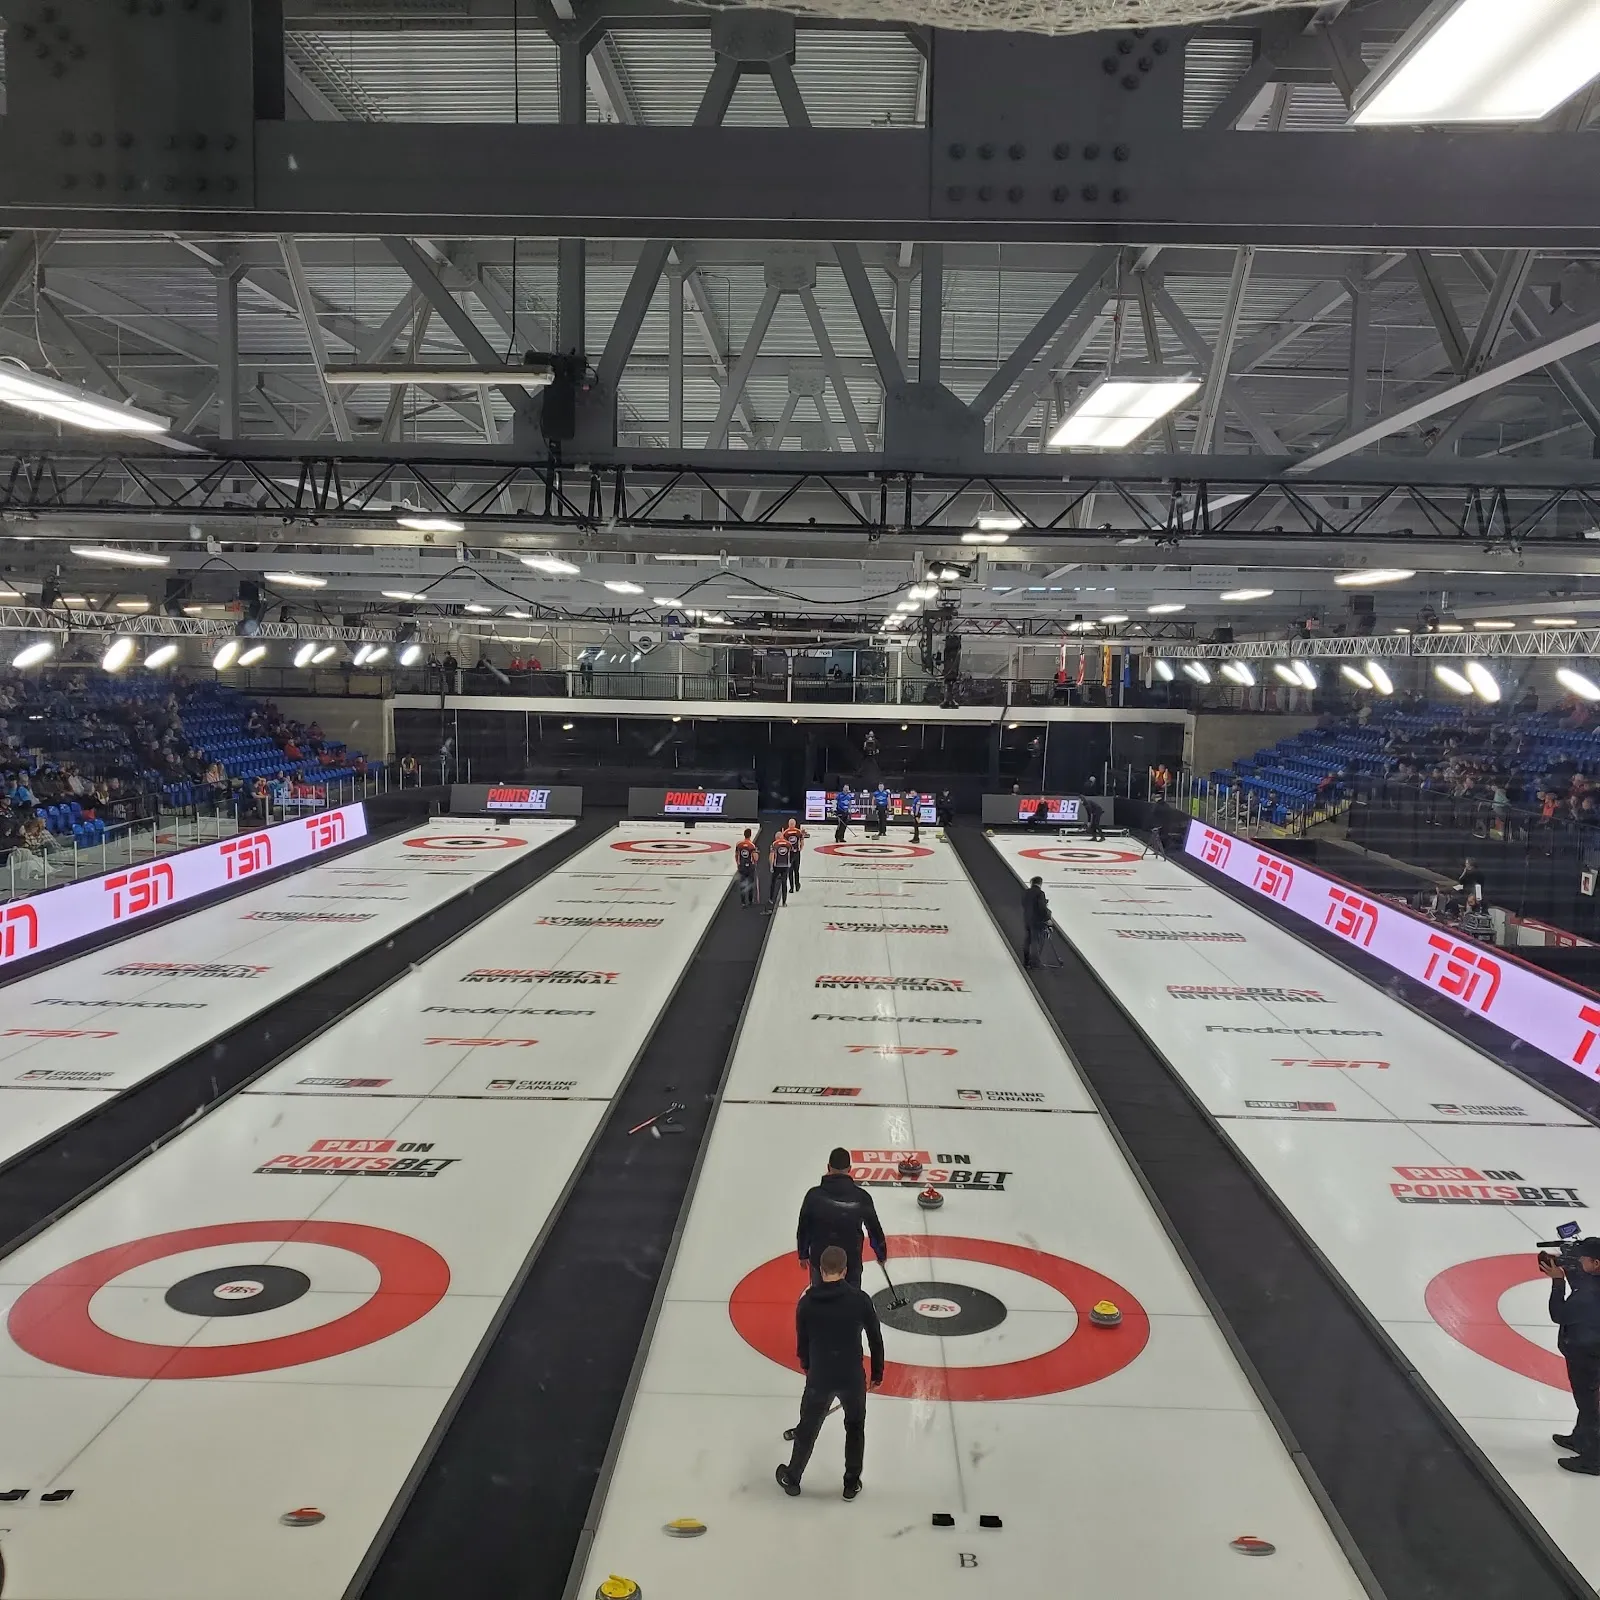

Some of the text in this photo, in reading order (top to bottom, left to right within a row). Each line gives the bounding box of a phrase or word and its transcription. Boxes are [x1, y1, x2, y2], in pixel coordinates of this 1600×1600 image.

[488, 788, 551, 802] POINTSBET
[665, 792, 727, 806] POINTSBET
[1020, 800, 1080, 812] POITSBET
[306, 812, 345, 850] TSN
[1200, 830, 1231, 869] TSN
[220, 834, 272, 880] TSN
[1254, 854, 1294, 901] TSN
[104, 863, 174, 919] TSN
[1324, 888, 1378, 947] TSN
[102, 968, 260, 979] INVITATIONAL
[471, 968, 593, 978] POINTSBET
[1424, 934, 1501, 1012] TSN
[458, 976, 618, 984] INVITATIONAL
[816, 976, 932, 984] POINTSBET
[814, 983, 972, 992] INVITATIONAL
[1167, 984, 1285, 994] POINTSBET
[1170, 990, 1338, 1003] INVITATIONAL
[1, 1028, 119, 1038] TSN
[1206, 1024, 1384, 1037] Fredericton
[423, 1037, 540, 1047] TSN
[844, 1045, 959, 1056] TSN
[1270, 1058, 1391, 1070] TSN
[1462, 1104, 1528, 1112] CURLING
[1466, 1109, 1530, 1117] CANADA
[323, 1140, 436, 1152] PLAY ON
[260, 1154, 462, 1171] POINTSBET
[937, 1154, 971, 1164] ON
[261, 1168, 431, 1177] CANADA
[1407, 1168, 1526, 1180] PLAY ON
[862, 1180, 998, 1190] ANADA
[1389, 1183, 1580, 1200] POINTSBET
[1402, 1198, 1579, 1208] CANADA
[958, 1553, 978, 1568] B
